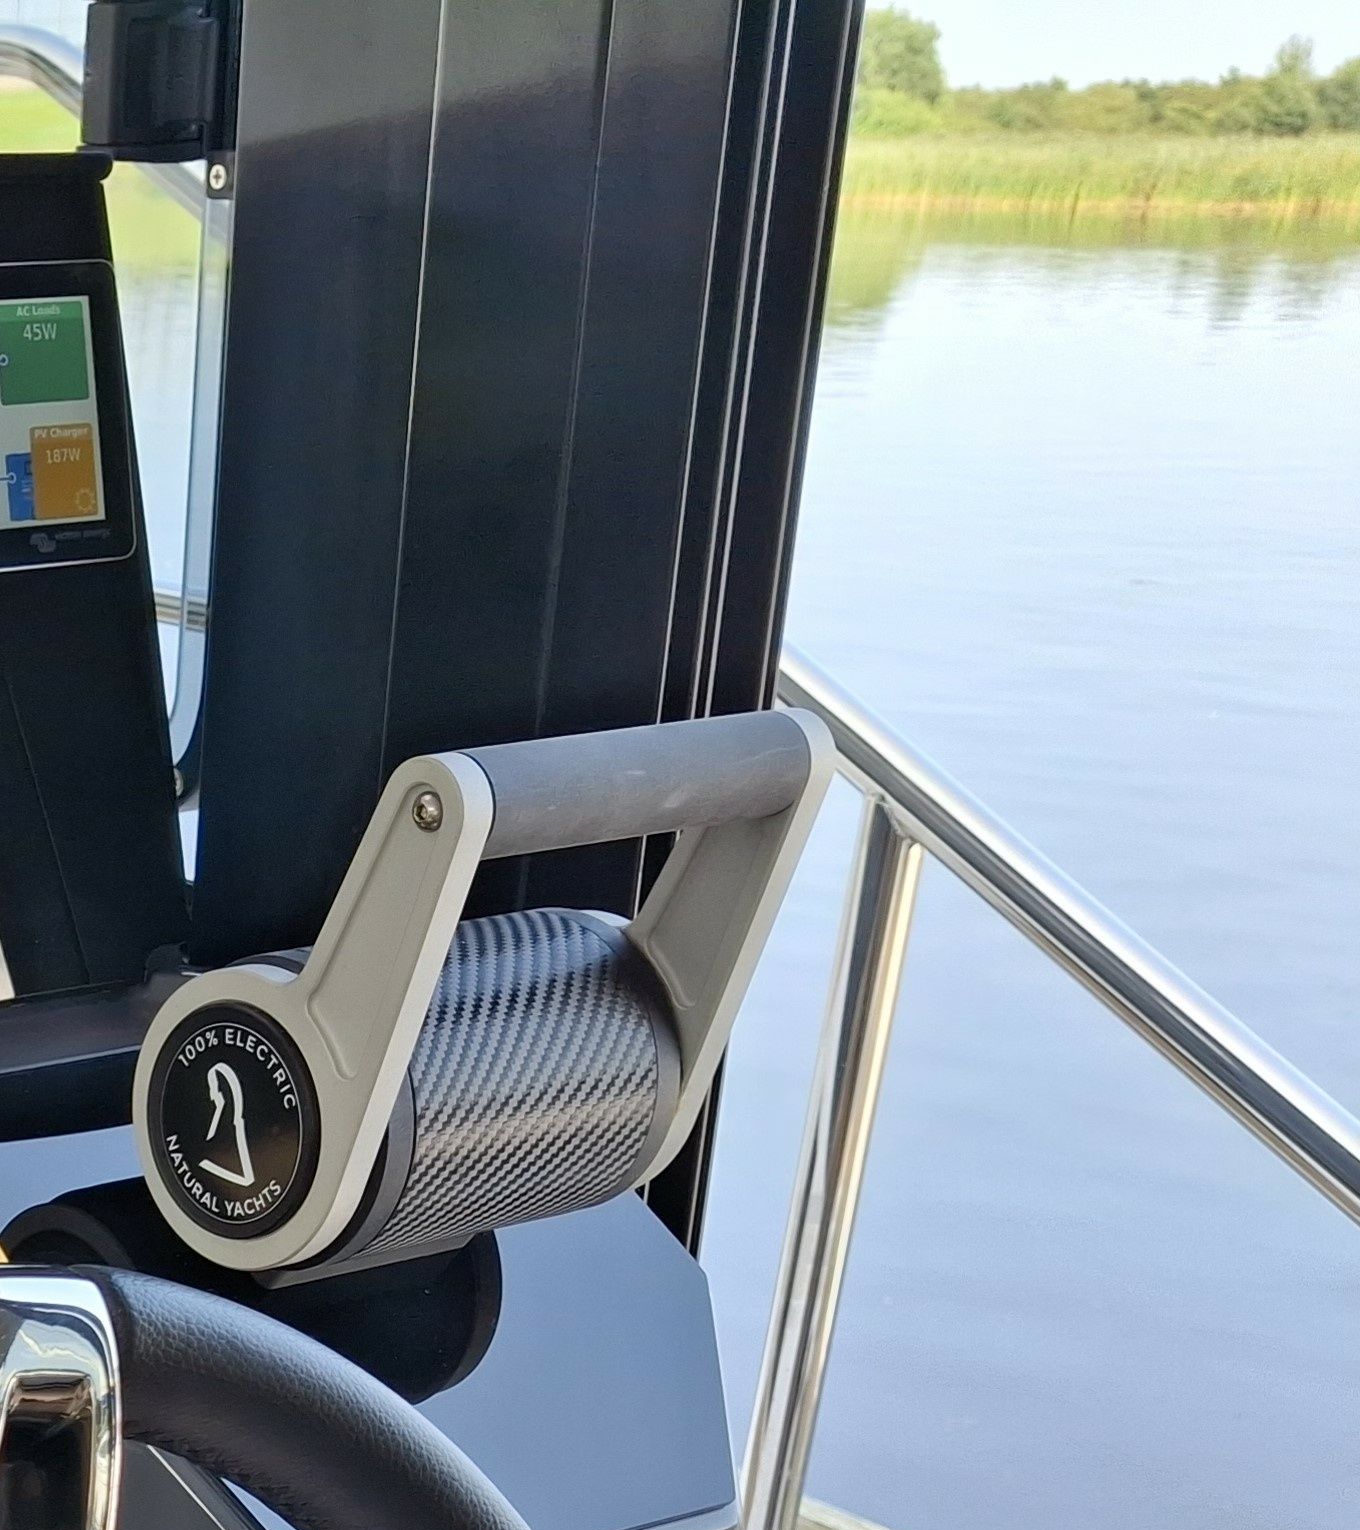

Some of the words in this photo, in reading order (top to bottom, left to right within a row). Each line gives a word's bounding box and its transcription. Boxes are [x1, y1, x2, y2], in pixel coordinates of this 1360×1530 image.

[16, 306, 30, 317] AC
[32, 305, 61, 316] Loads
[23, 322, 57, 341] 45W
[34, 428, 47, 439] PV
[49, 426, 89, 439] Charger
[46, 448, 81, 464] 187W
[176, 1028, 219, 1068] 100%
[224, 1028, 298, 1110] ELECTRIC
[166, 1133, 221, 1213] NATURAL
[223, 1178, 282, 1218] YACHTS
